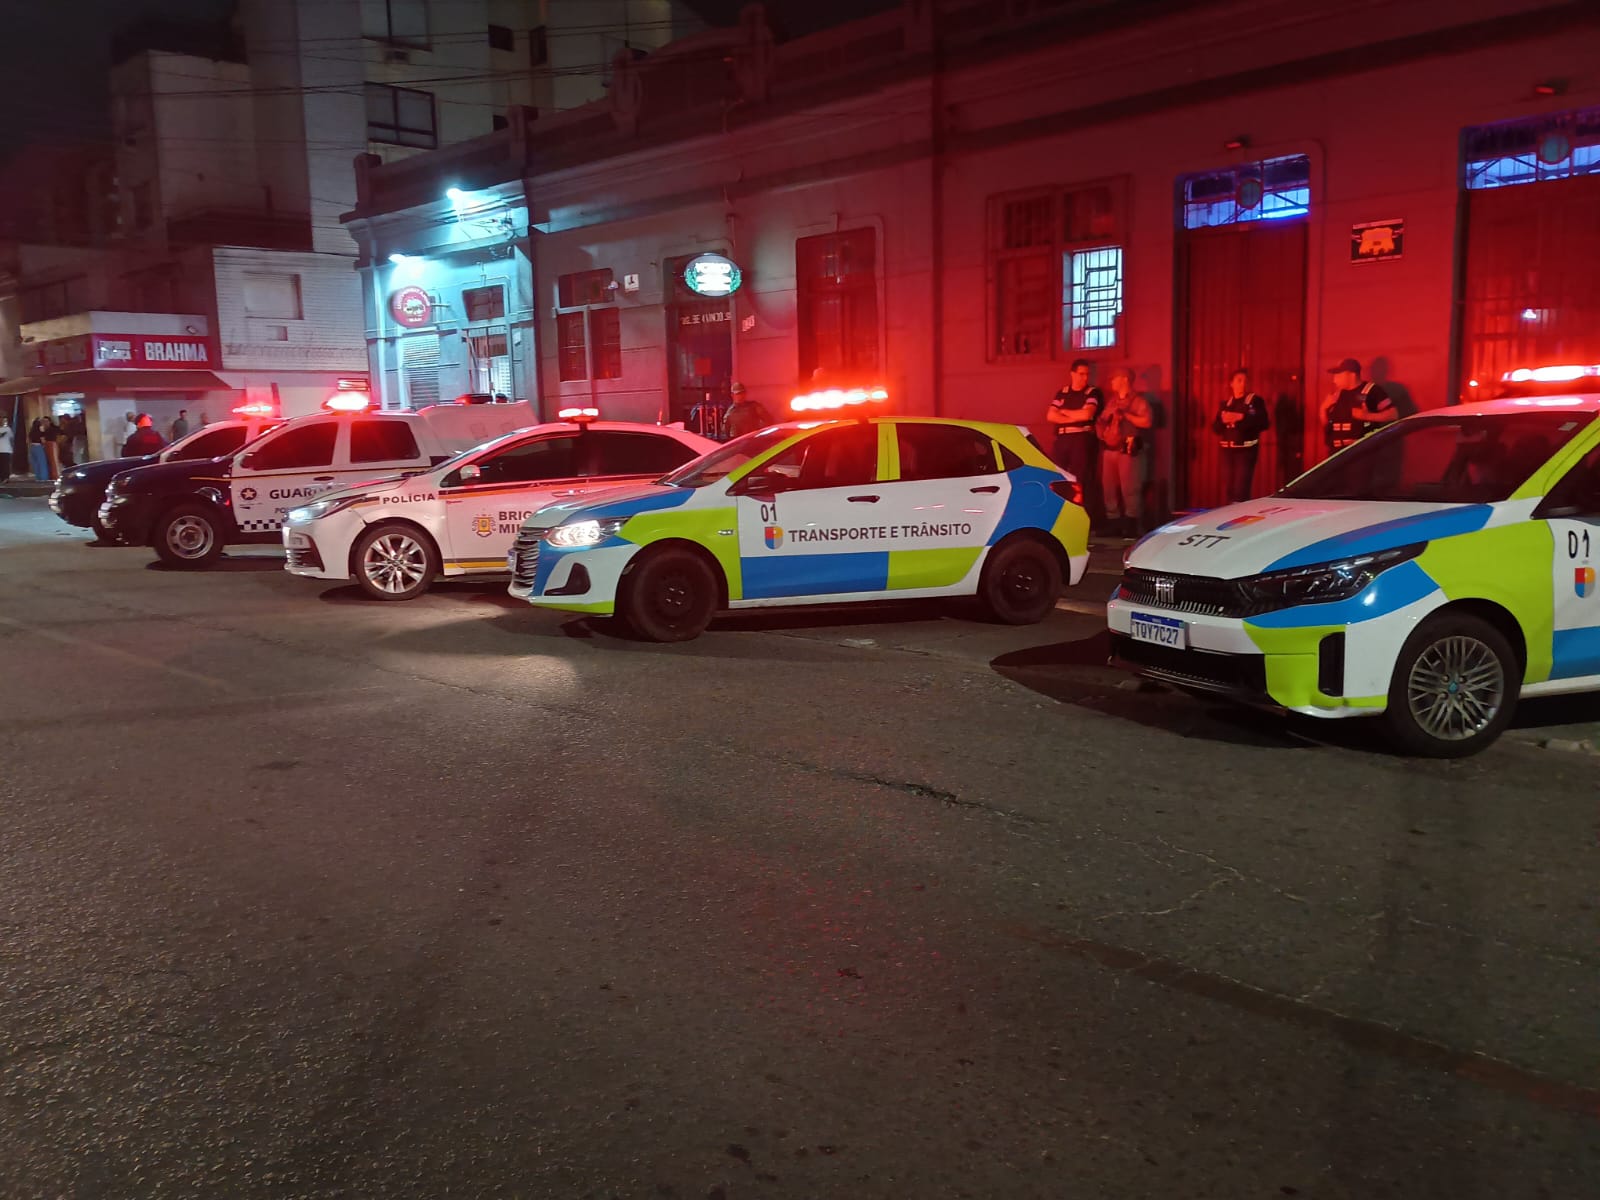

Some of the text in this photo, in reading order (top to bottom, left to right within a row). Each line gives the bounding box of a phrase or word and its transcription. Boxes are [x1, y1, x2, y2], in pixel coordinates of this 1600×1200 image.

[144, 342, 208, 361] BRAHMA
[499, 511, 532, 521] BRIG
[761, 503, 777, 523] 01
[788, 522, 972, 542] TRANSPORTE E TRÂNSITO
[1178, 534, 1230, 549] STT
[1568, 529, 1590, 559] 01
[1134, 621, 1179, 645] TQY7C27
